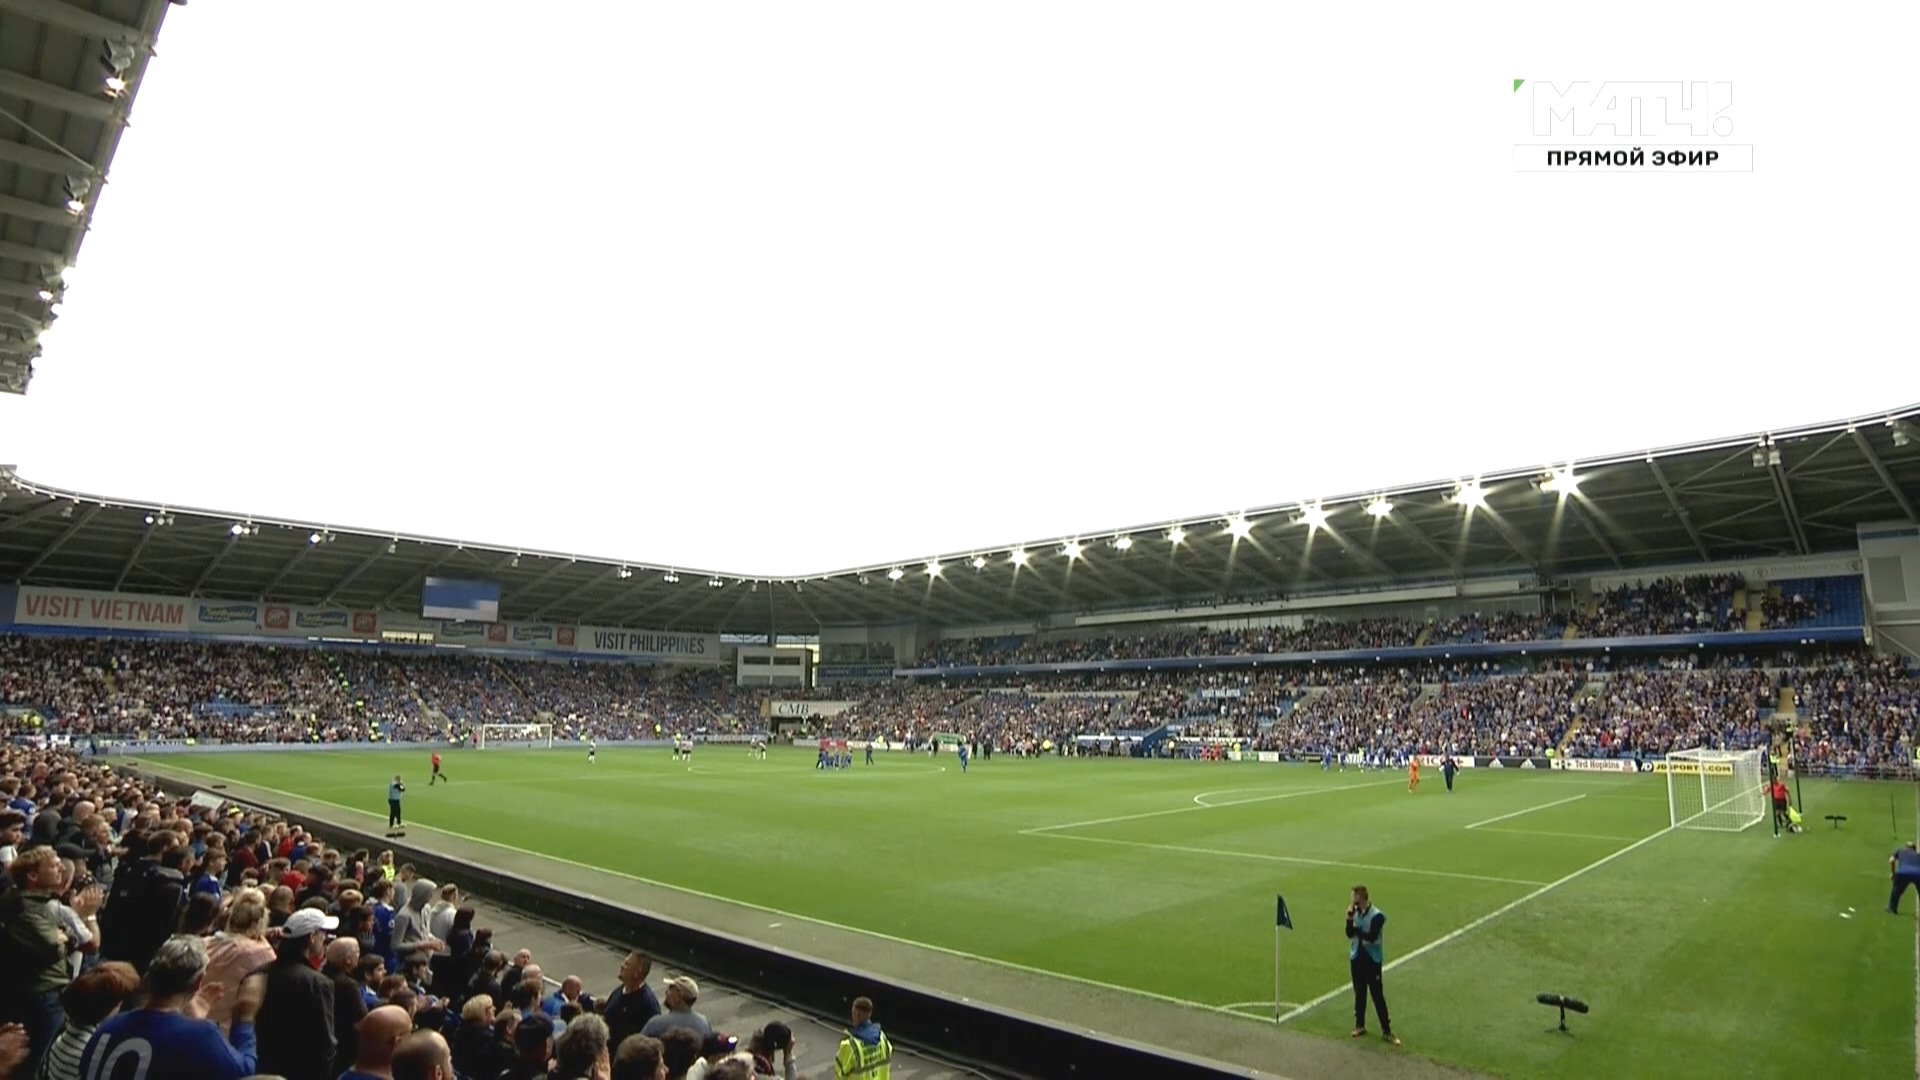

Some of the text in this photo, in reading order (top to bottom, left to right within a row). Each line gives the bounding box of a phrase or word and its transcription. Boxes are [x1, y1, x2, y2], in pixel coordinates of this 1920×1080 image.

[26, 594, 185, 624] VISIT VIETNAM
[594, 631, 627, 650] VISIT
[630, 634, 705, 654] PHILIPPINES
[778, 702, 809, 715] CMB
[1575, 759, 1620, 771] Ted Hopkins
[1656, 763, 1731, 772] JDPORT.COM
